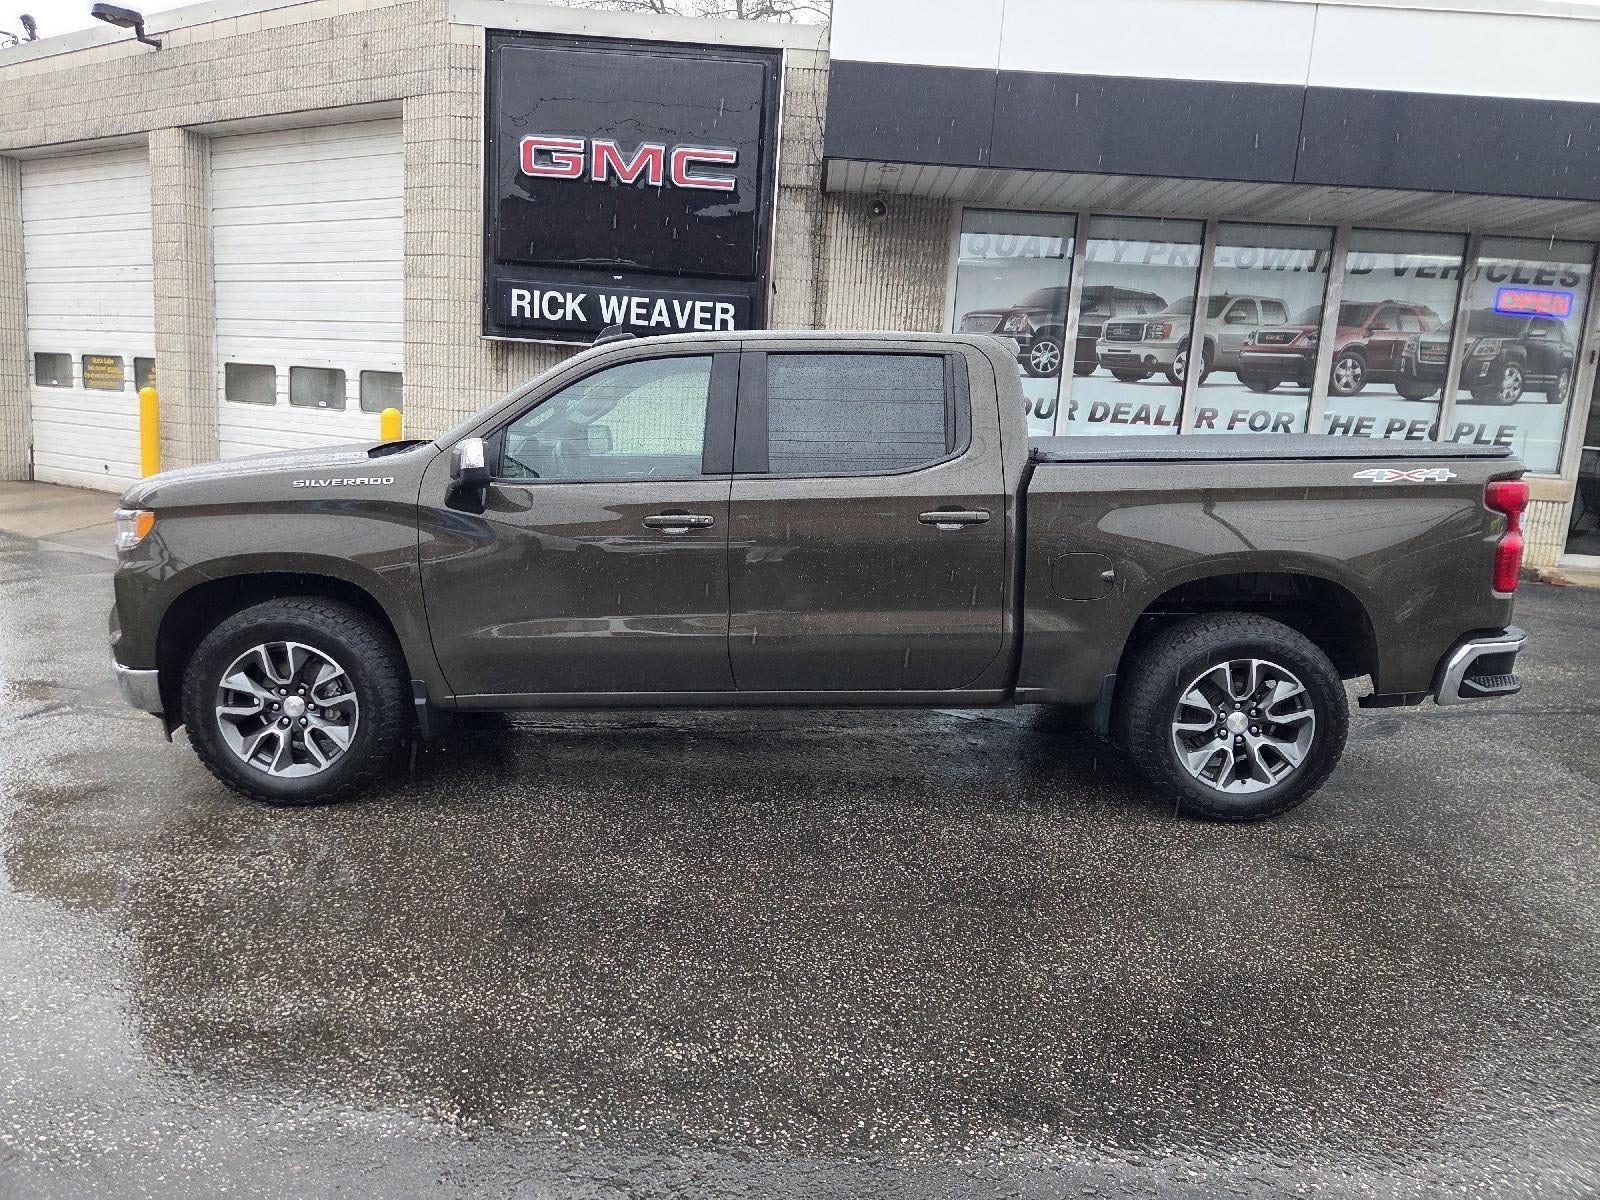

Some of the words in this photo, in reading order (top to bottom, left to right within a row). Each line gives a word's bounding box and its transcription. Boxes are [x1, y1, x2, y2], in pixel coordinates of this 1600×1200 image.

[519, 135, 738, 191] GMC
[967, 234, 1132, 263] QUALTY
[511, 288, 588, 322] RICK
[599, 294, 736, 331] WEAVER
[1500, 290, 1570, 315] OPEN
[1226, 409, 1296, 434] FOR
[292, 476, 395, 488] SILVERADO
